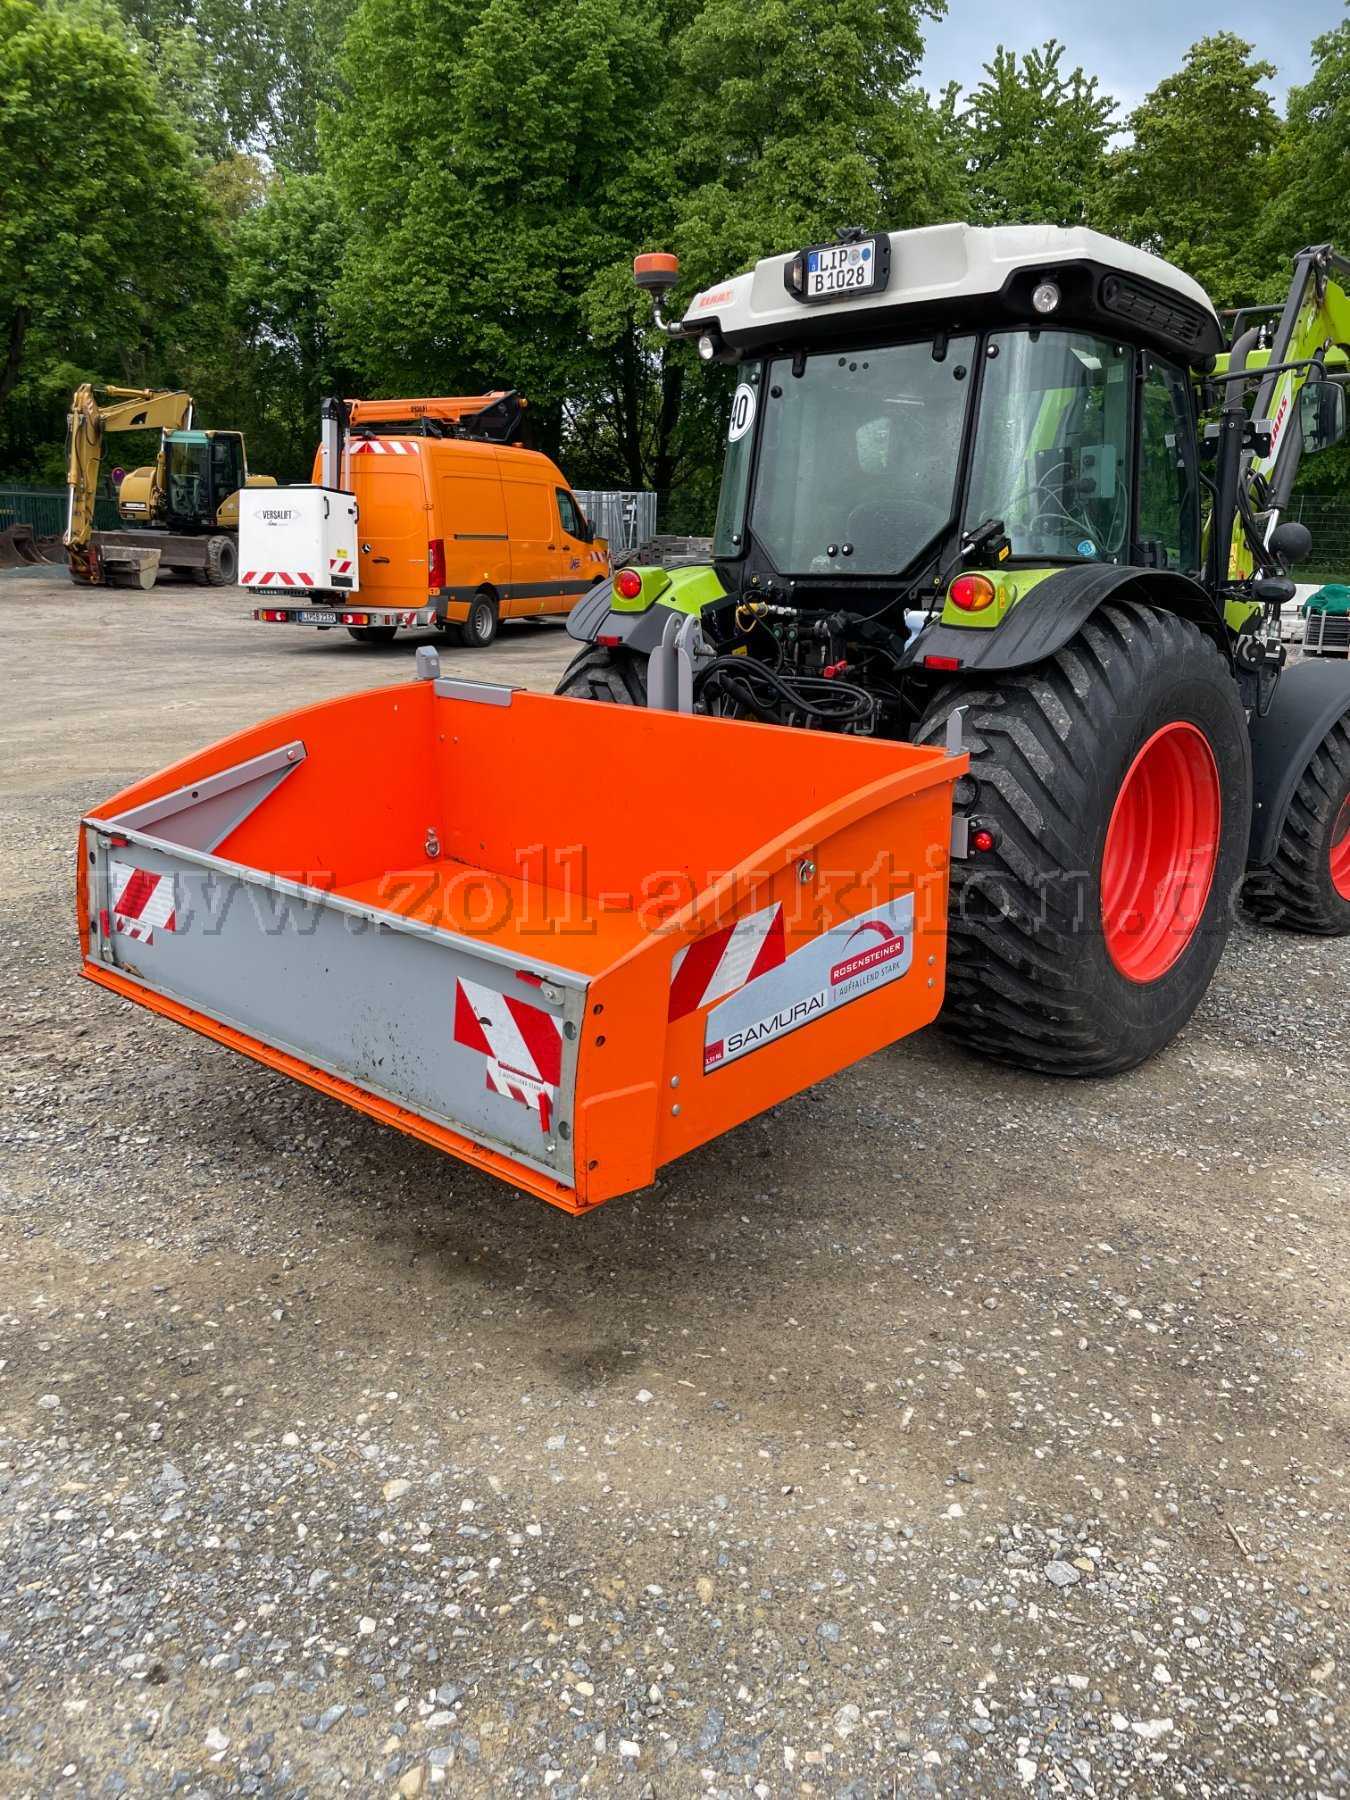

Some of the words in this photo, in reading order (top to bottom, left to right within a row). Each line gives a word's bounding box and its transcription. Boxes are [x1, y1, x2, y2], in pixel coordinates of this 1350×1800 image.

[820, 249, 848, 272] LIP
[815, 266, 865, 292] B1028
[262, 510, 292, 520] VERSALIFT
[833, 942, 901, 980] ROSENSTEINER
[839, 969, 879, 996] AUFFALLEND
[881, 961, 901, 977] STARK
[728, 992, 825, 1052] SAMURAI
